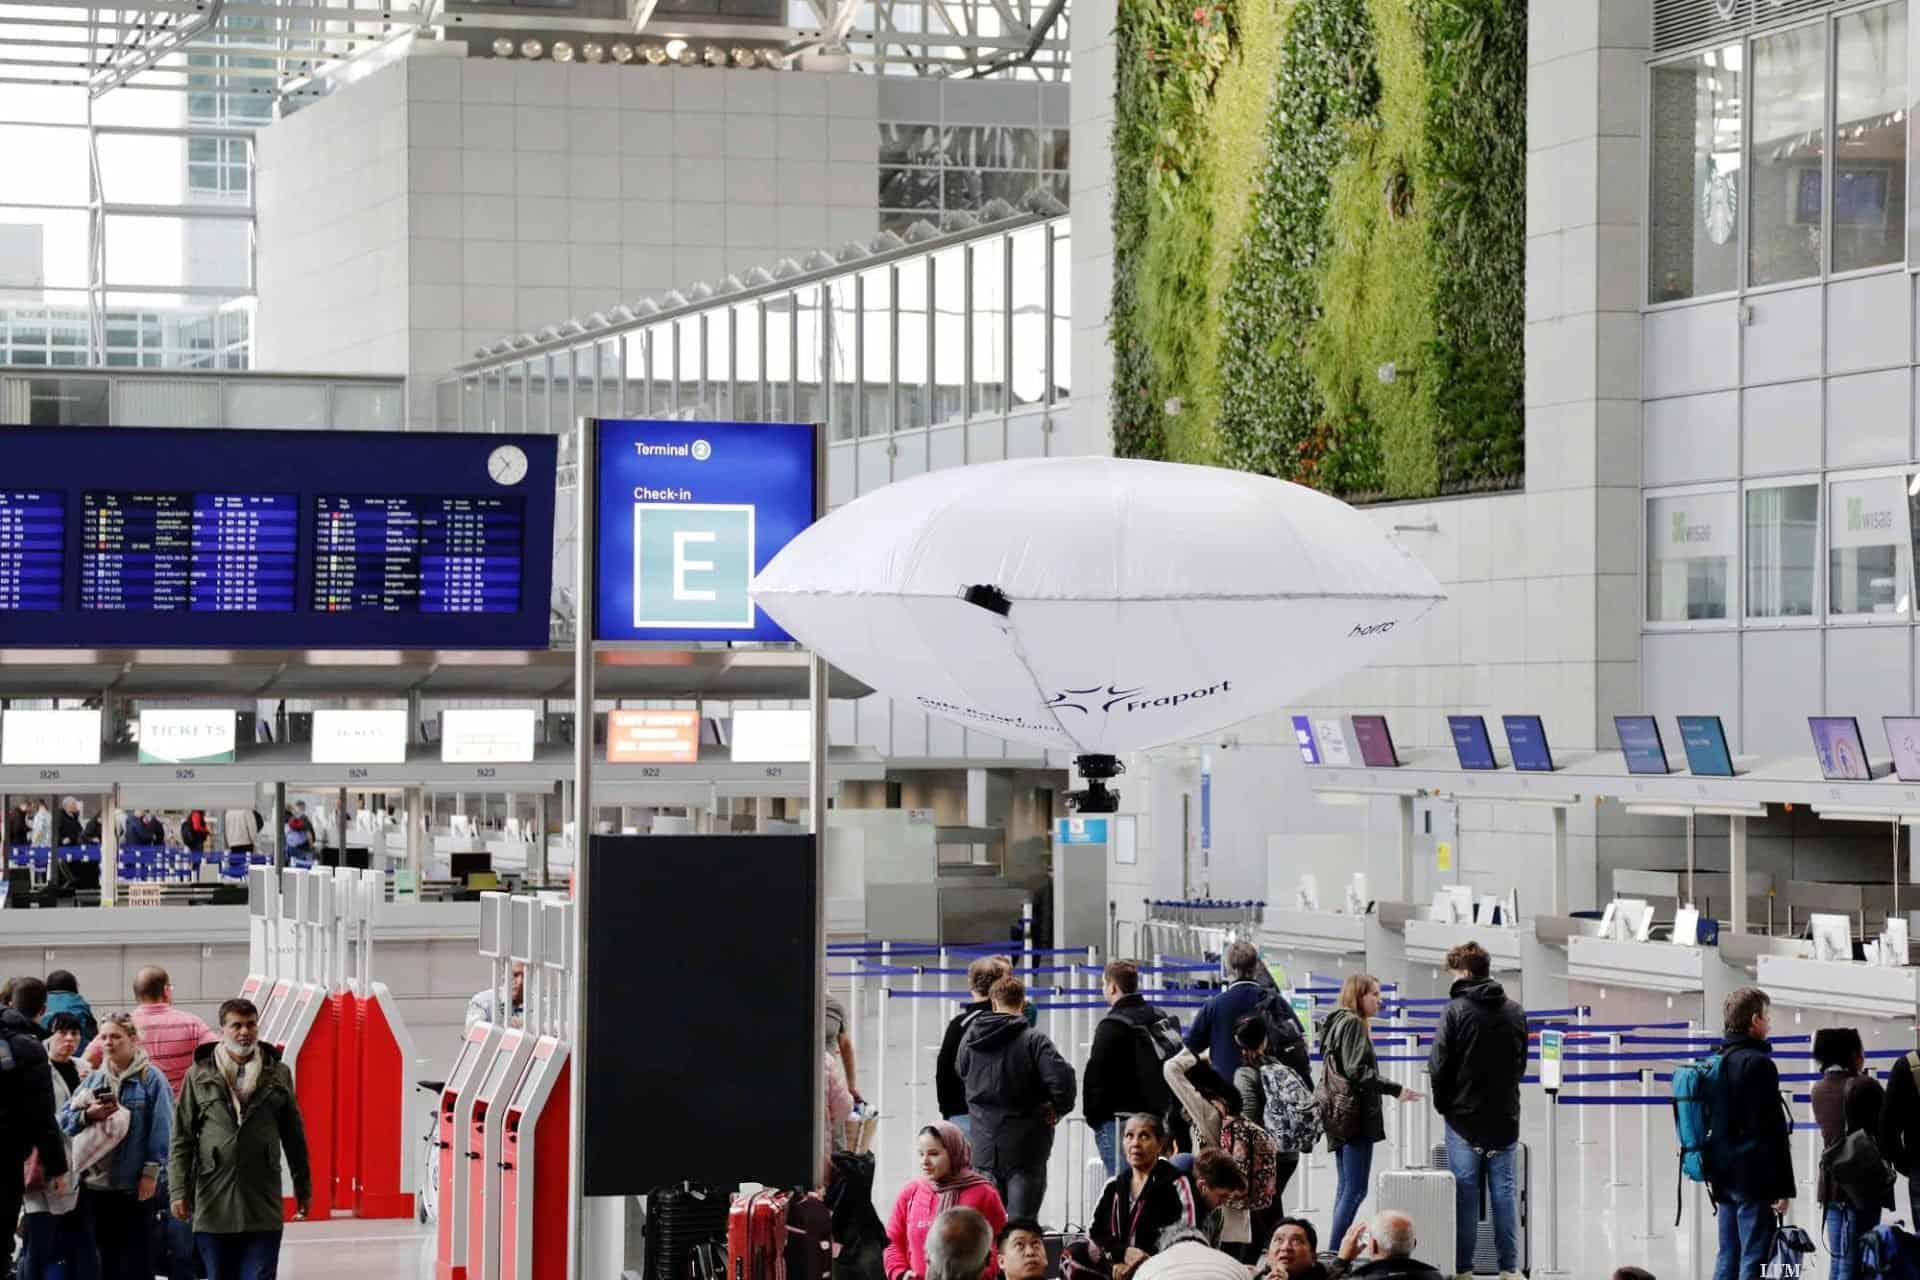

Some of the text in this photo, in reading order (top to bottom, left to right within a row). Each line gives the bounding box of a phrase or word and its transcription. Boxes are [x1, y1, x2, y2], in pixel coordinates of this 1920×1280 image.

[634, 442, 689, 456] Terminal
[633, 487, 692, 500] Check-in
[673, 531, 716, 601] E
[1127, 680, 1232, 712] Fraport
[150, 724, 226, 737] TICKETS
[477, 768, 496, 777] 923
[642, 768, 660, 777] 922
[766, 768, 782, 777] 921
